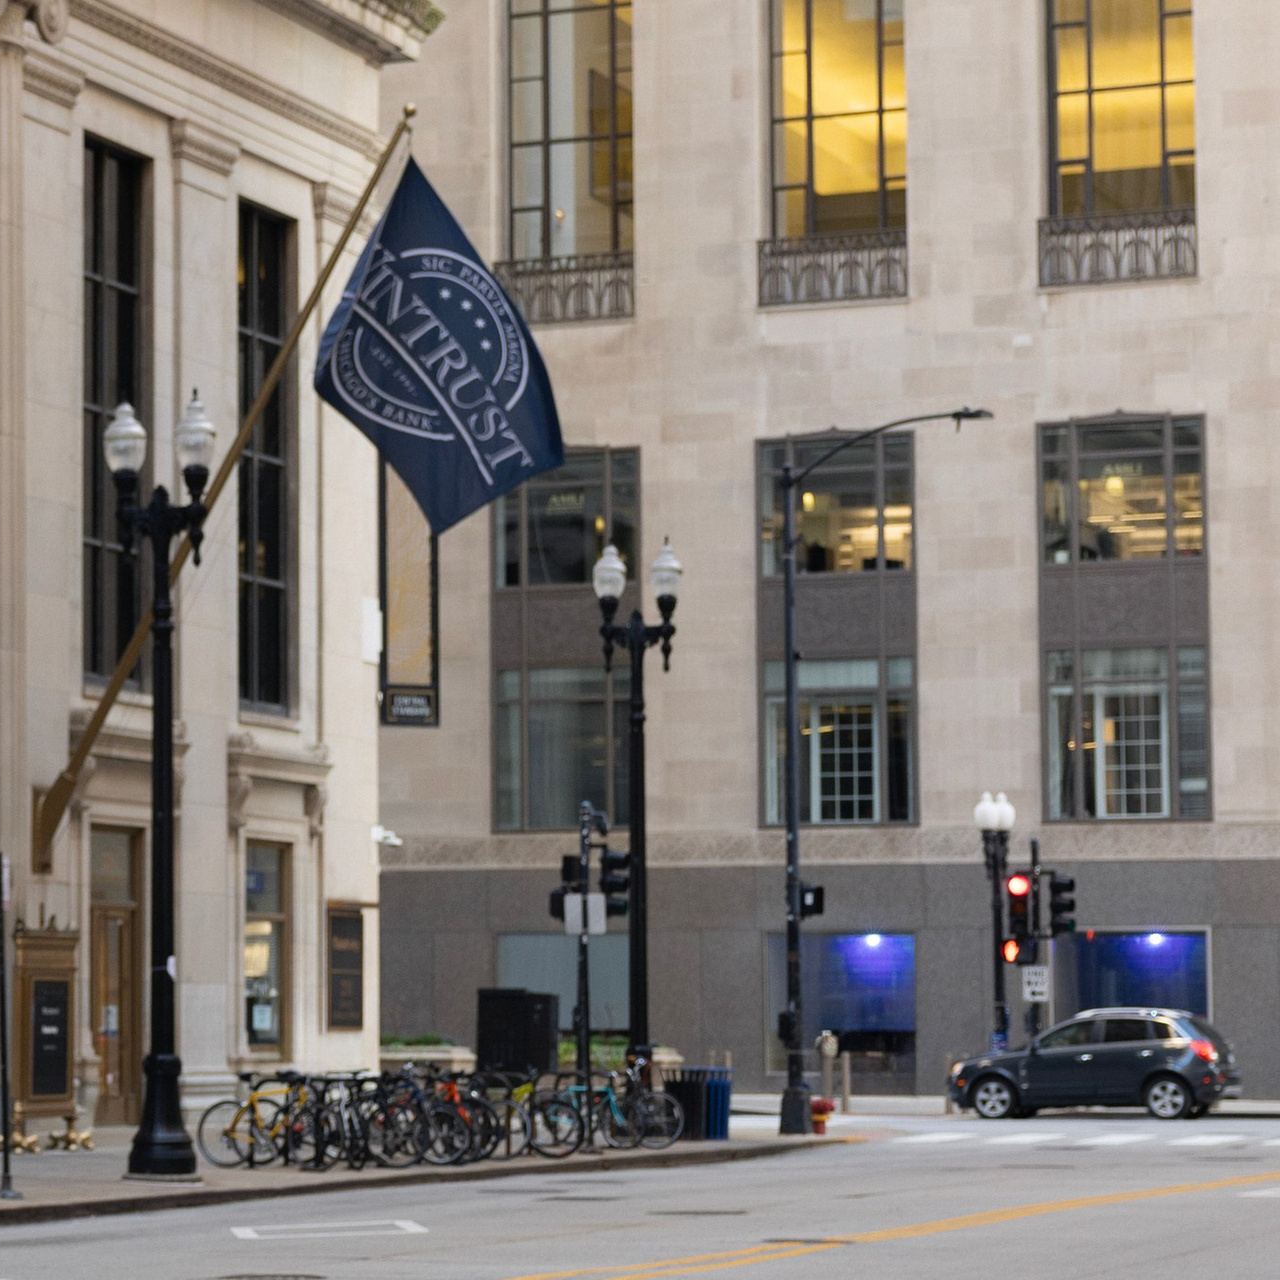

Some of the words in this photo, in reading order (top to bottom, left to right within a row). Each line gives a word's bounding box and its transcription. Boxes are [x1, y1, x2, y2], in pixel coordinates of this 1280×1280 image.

[421, 255, 453, 273] SIC
[459, 265, 506, 317] PARVIS
[381, 403, 433, 432] BANK
